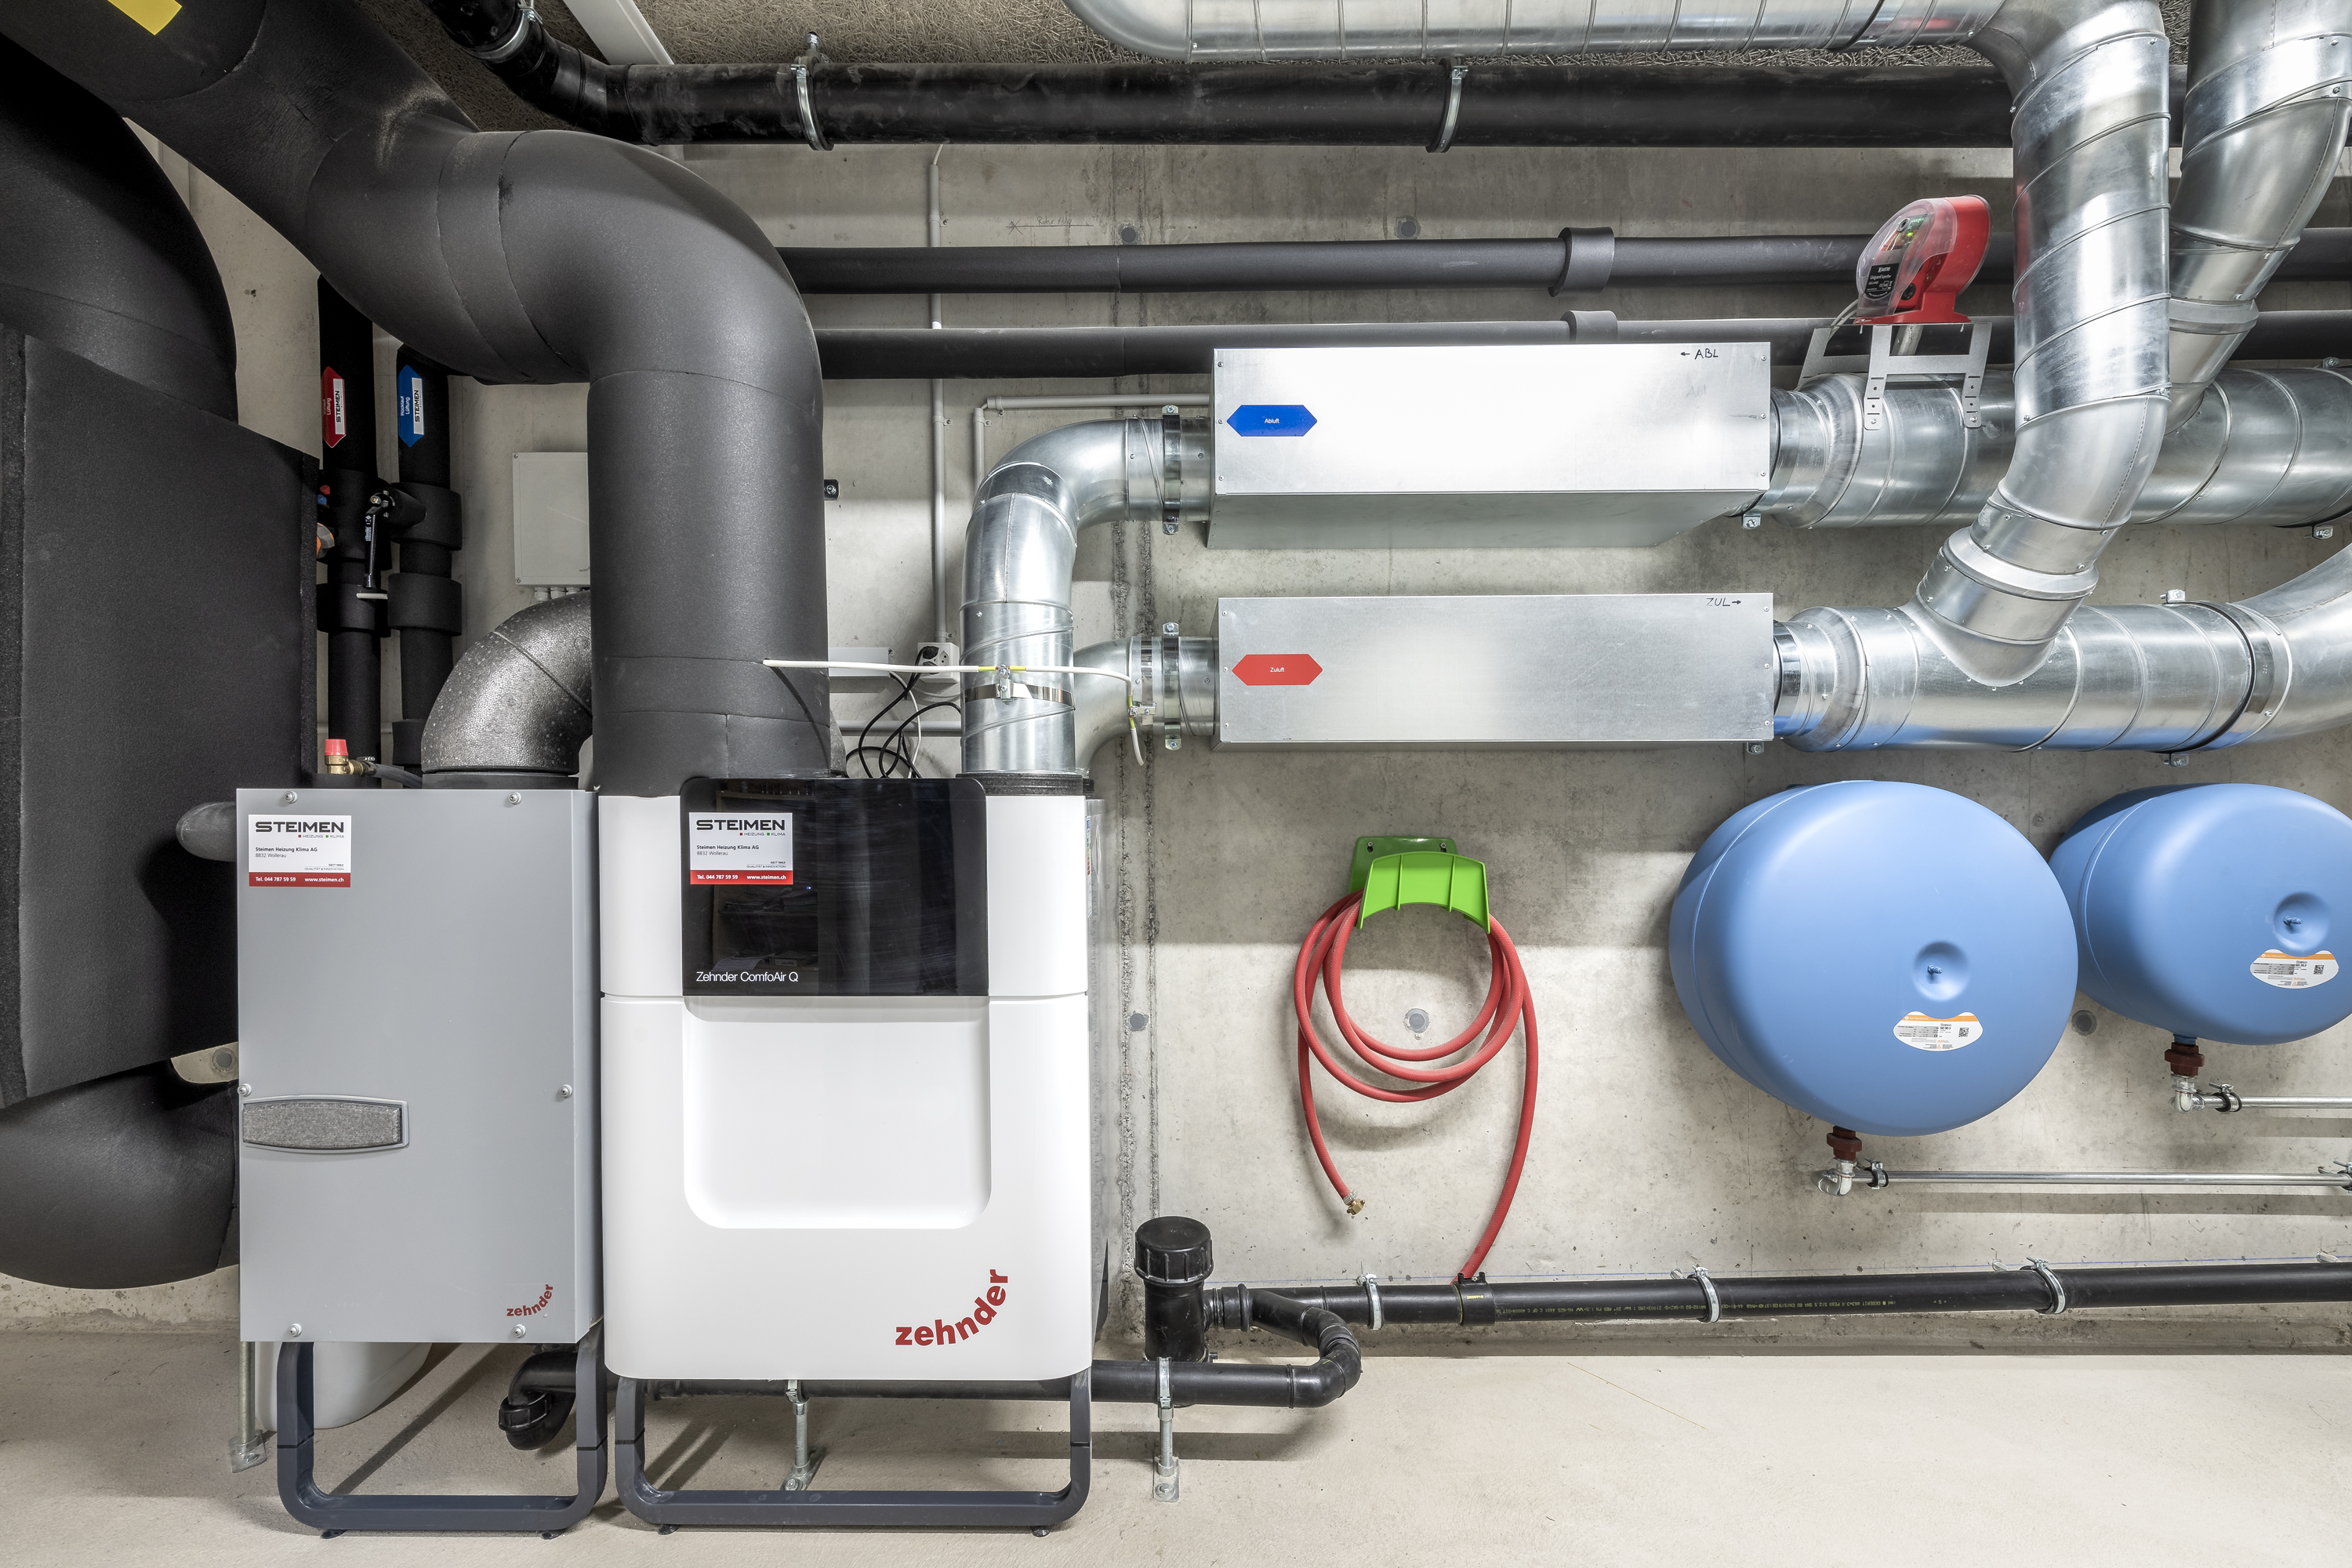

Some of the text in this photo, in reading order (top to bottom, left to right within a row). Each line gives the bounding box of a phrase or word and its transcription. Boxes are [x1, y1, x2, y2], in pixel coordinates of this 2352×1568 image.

[1695, 348, 1719, 360] ABL
[1707, 597, 1730, 606] ZUL
[256, 822, 343, 833] STEIMEN
[696, 819, 785, 830] STEIMEN
[696, 971, 798, 982] Zehnder ComfoAir Q
[506, 1284, 554, 1316] zehnder
[895, 1269, 1008, 1346] zehnder
